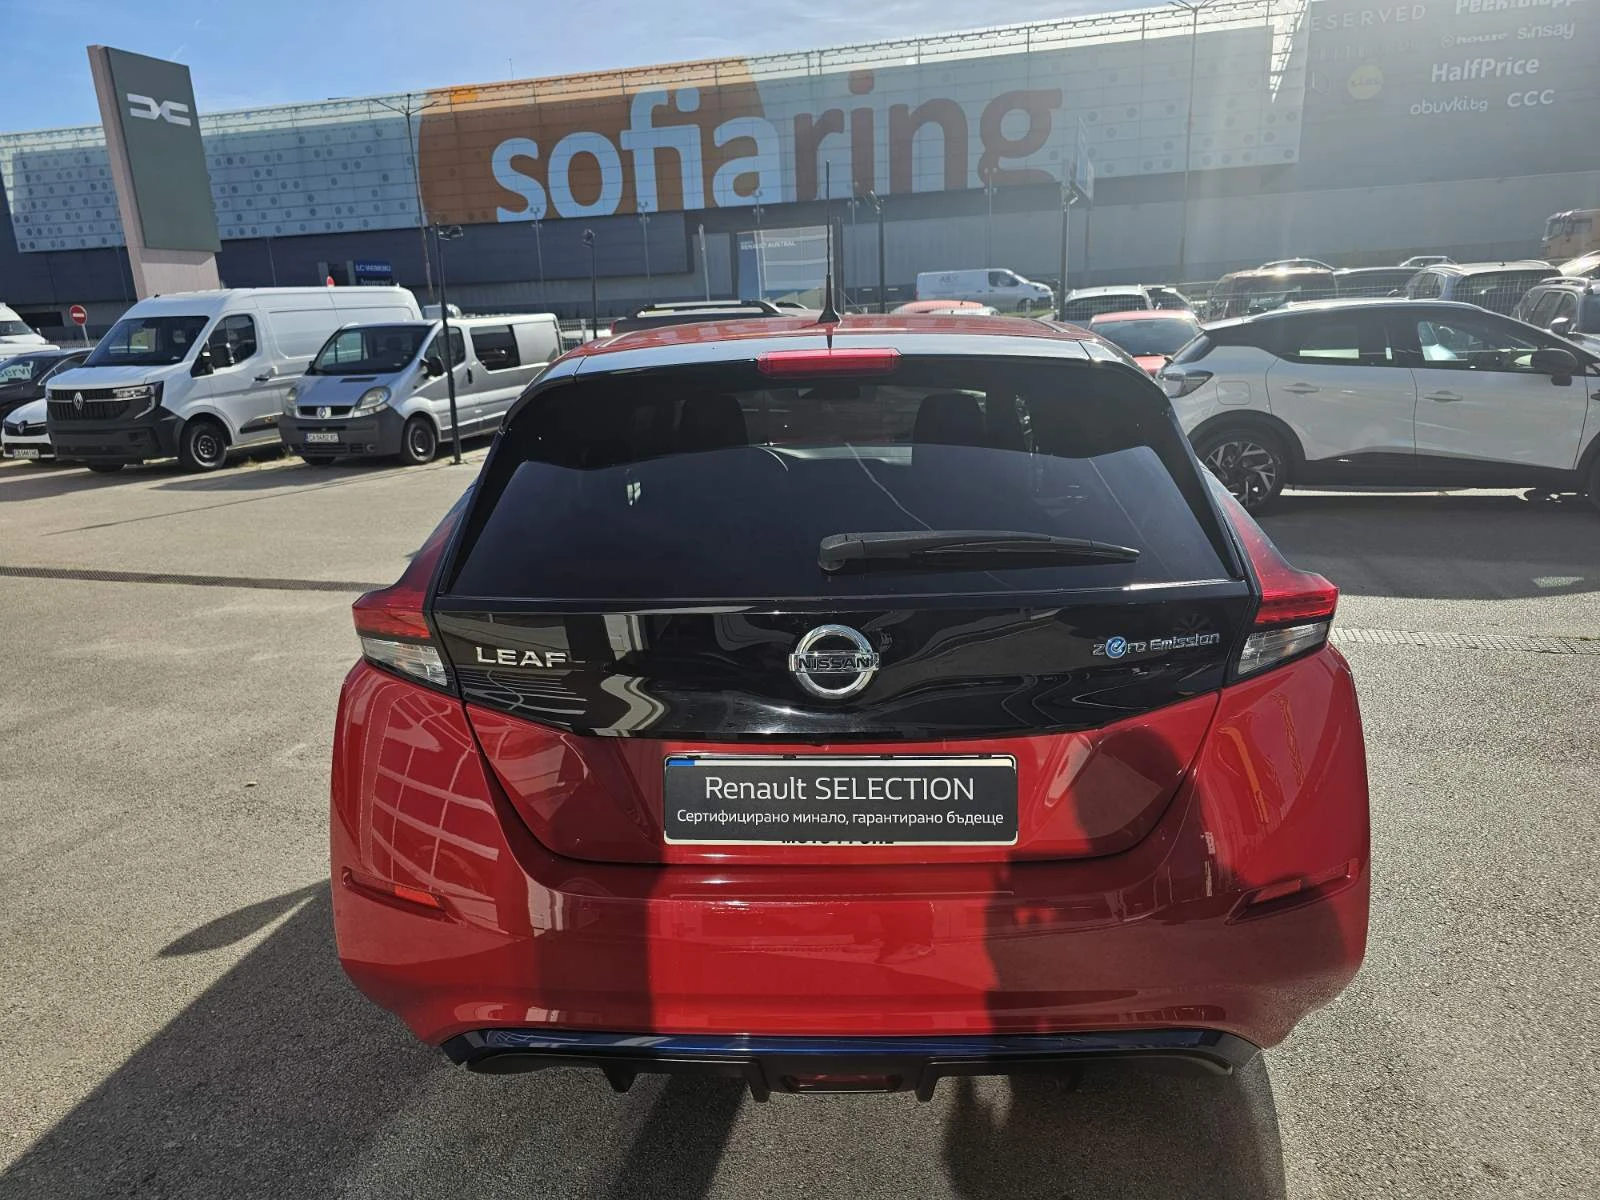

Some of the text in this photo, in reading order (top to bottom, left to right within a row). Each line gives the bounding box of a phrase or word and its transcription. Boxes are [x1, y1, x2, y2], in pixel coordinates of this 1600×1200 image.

[1310, 5, 1426, 32] ESERVED
[1431, 57, 1540, 83] HalfPrice
[1410, 96, 1488, 115] obuvki.bg
[1507, 89, 1556, 108] CCC
[491, 69, 1063, 224] sofiaring
[1149, 632, 1220, 651] Emission
[475, 646, 567, 668] LEAF
[798, 657, 871, 670] NISSAN
[704, 776, 974, 801] Renault SELECTION
[677, 809, 1004, 827] Сертифицирано минало, гарантирано бъдеще
